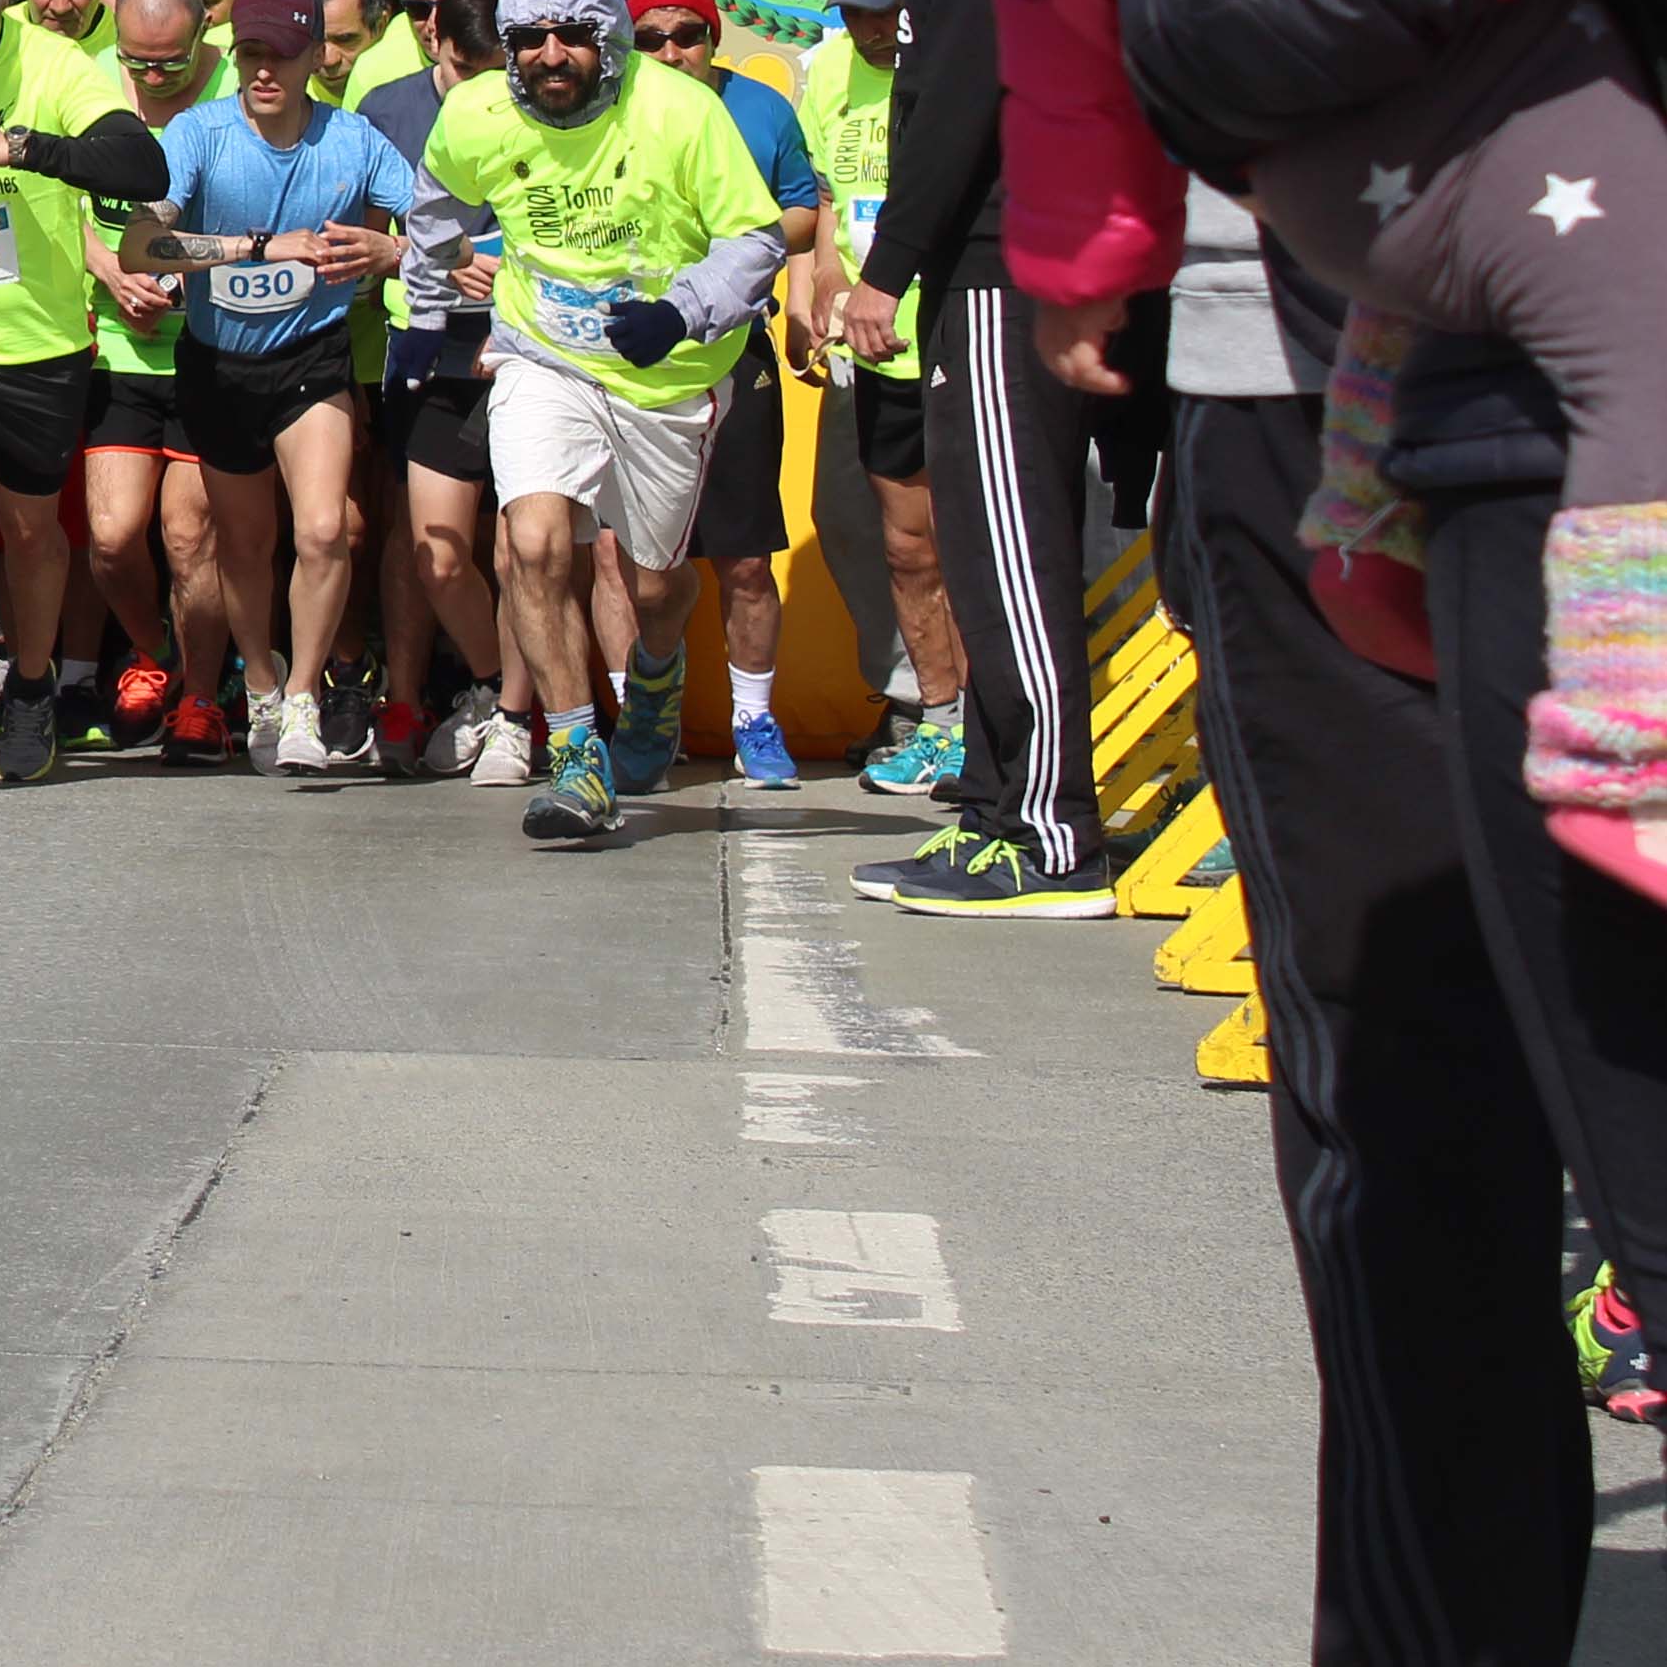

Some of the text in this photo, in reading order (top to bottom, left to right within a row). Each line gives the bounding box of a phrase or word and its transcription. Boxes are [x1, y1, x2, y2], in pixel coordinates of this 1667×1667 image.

[869, 118, 887, 143] To
[834, 119, 865, 184] CORRIDA
[560, 185, 614, 210] Toma
[525, 185, 563, 249] CORRIDA
[565, 219, 643, 256] Magallanes
[228, 269, 295, 299] 030
